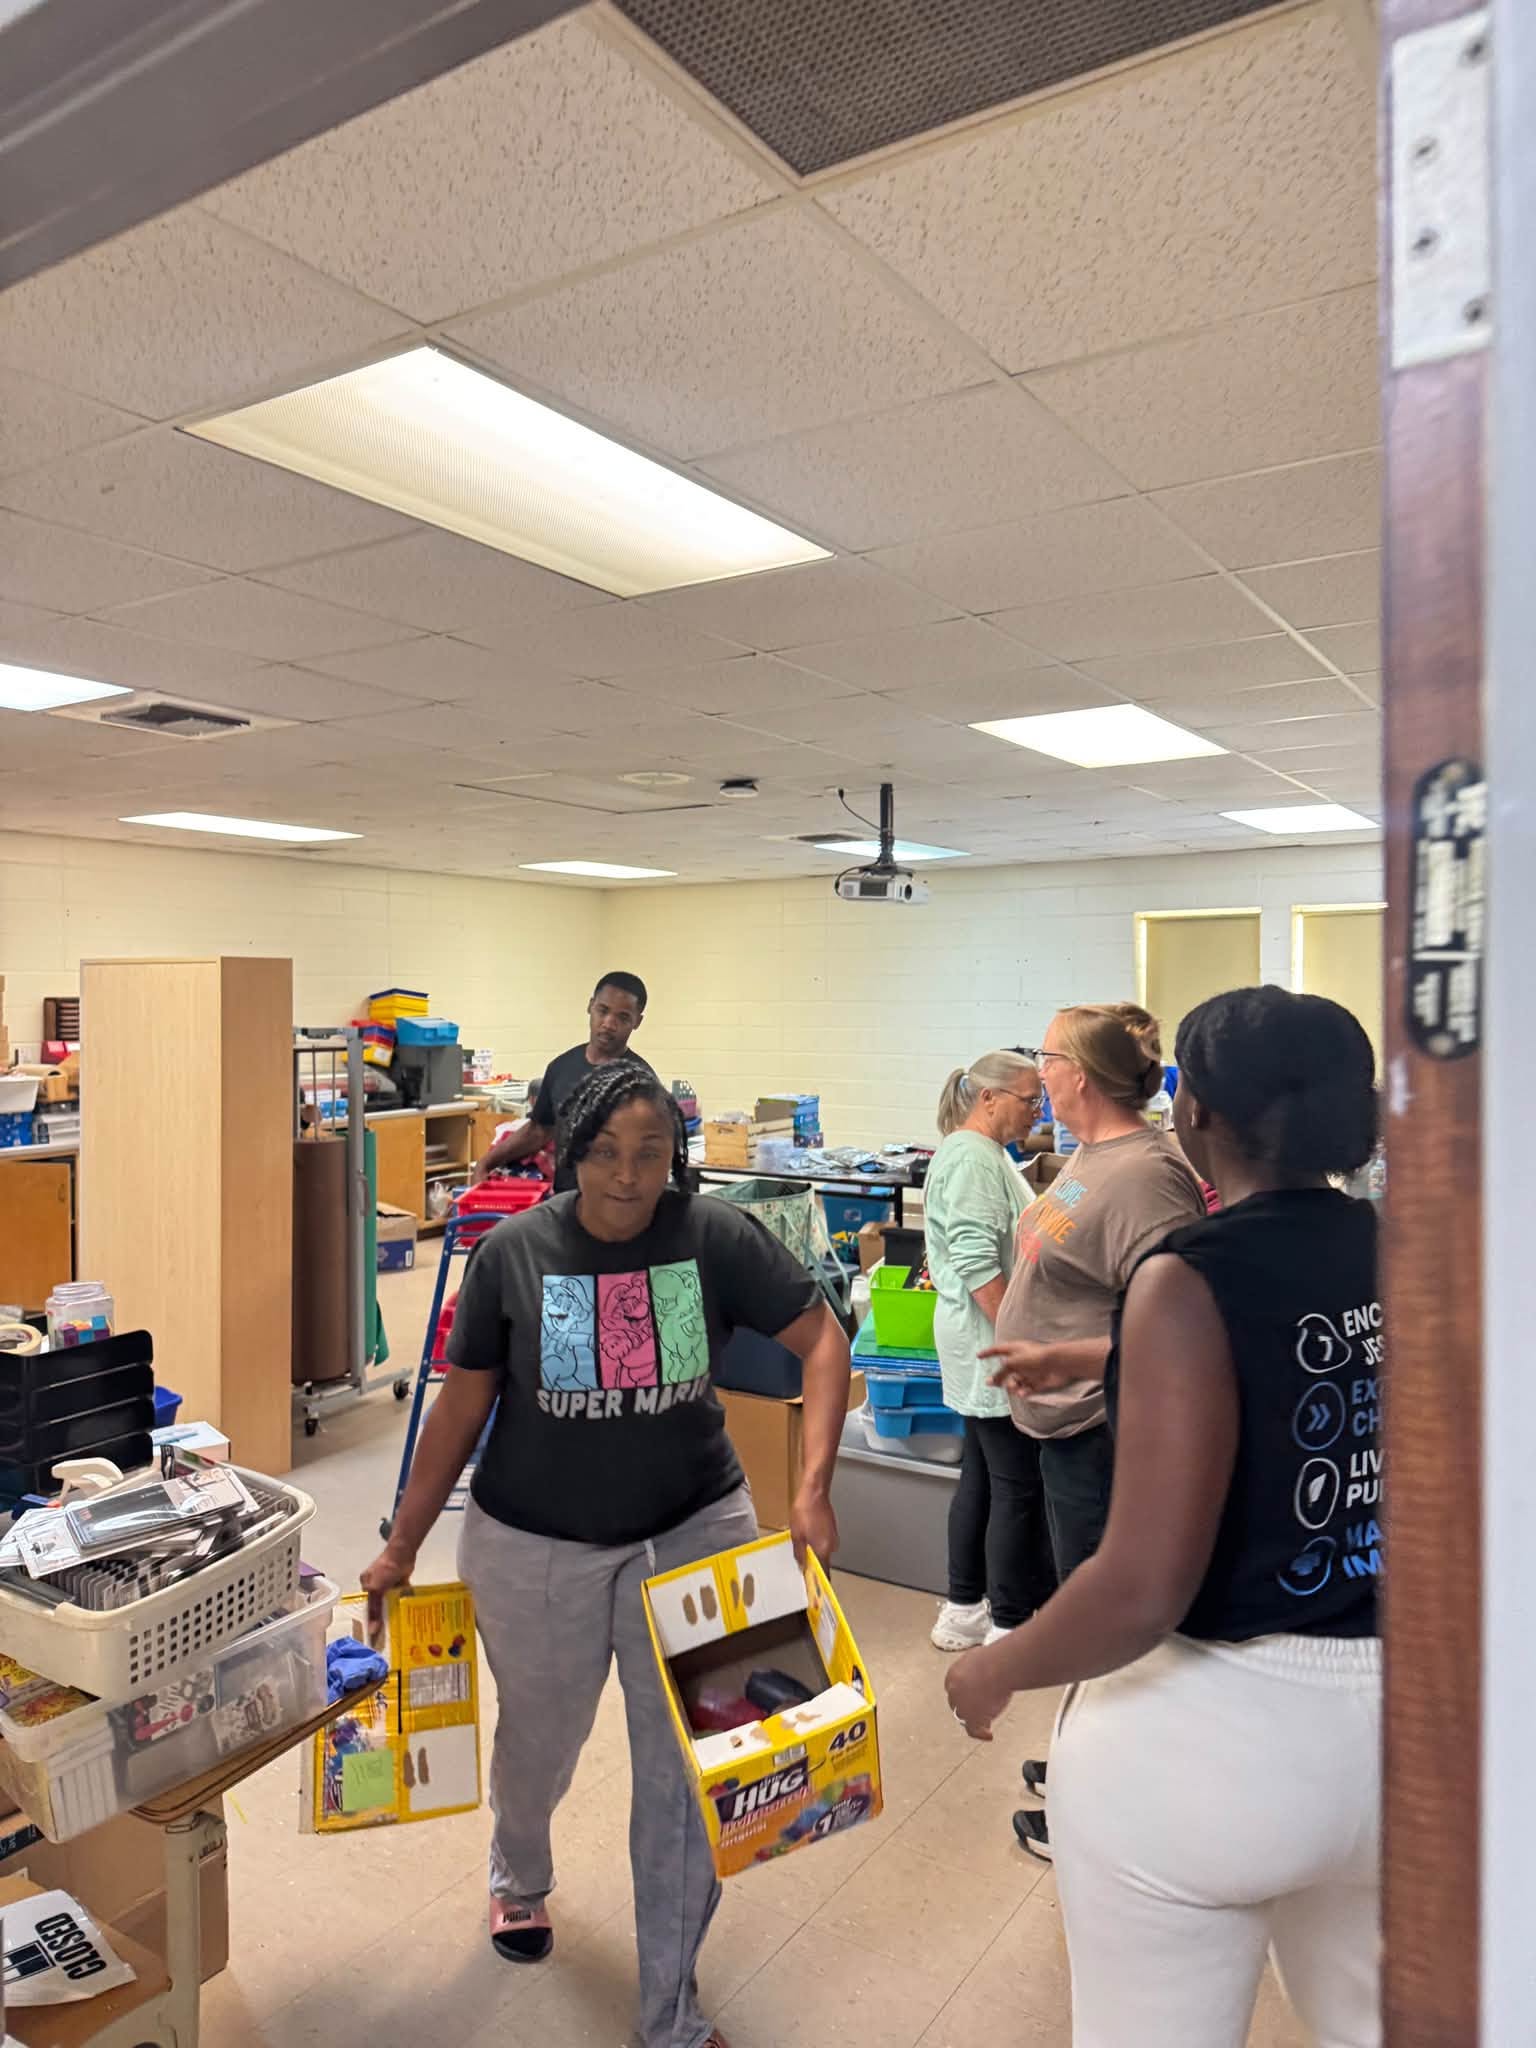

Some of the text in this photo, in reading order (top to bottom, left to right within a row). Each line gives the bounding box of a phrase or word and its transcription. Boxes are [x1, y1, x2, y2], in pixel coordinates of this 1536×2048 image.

[536, 1388, 623, 1419] SUPER
[1351, 1377, 1385, 1406] EX
[828, 1719, 867, 1753] 40
[732, 1767, 804, 1820] HUG
[35, 1912, 107, 1980] CLOSED
